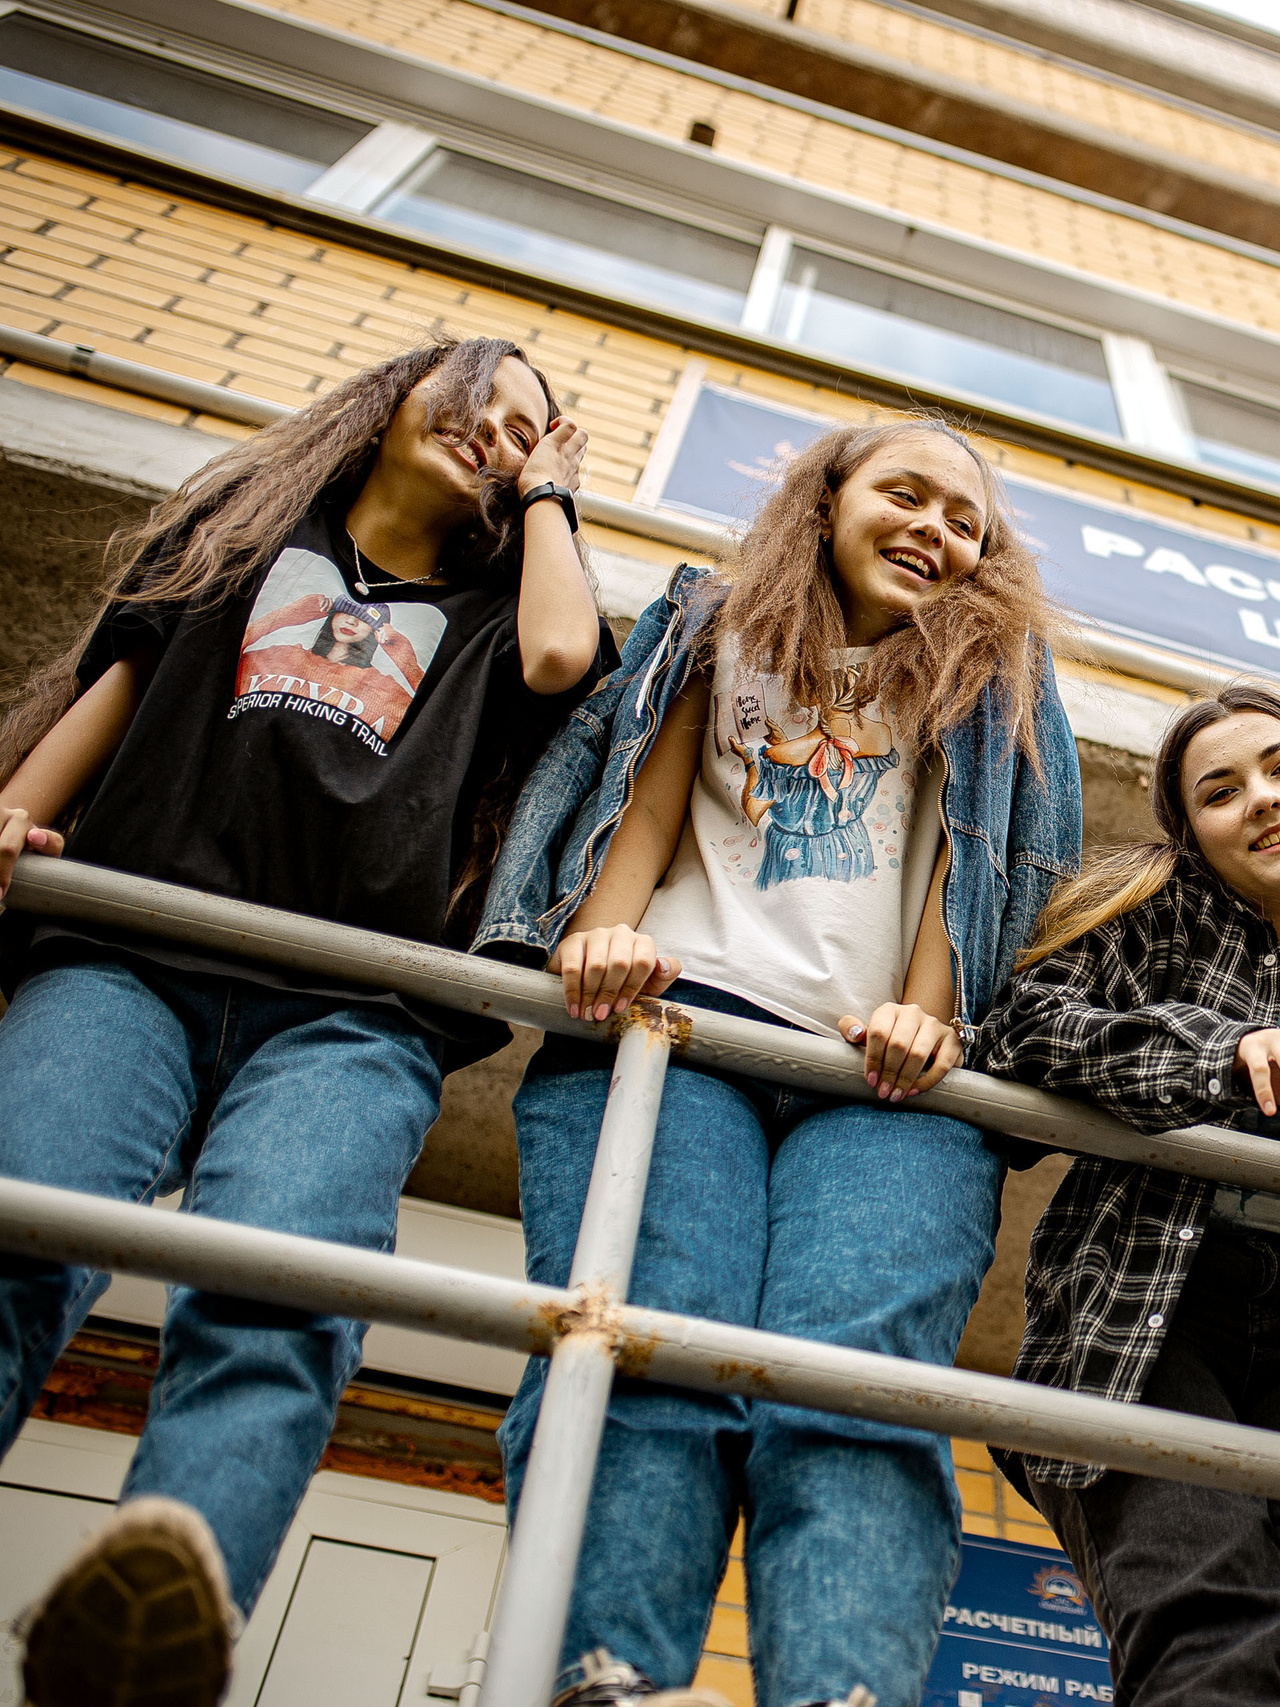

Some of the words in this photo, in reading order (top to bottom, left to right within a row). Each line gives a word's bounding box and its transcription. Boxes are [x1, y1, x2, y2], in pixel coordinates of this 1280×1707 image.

[227, 693, 283, 720] SPERIOR
[284, 696, 348, 726] HIKING
[350, 717, 389, 757] TRAIL
[943, 1605, 1102, 1649] РАСЧЕТНЫЙ
[961, 1662, 1060, 1693] РЕЖИМ
